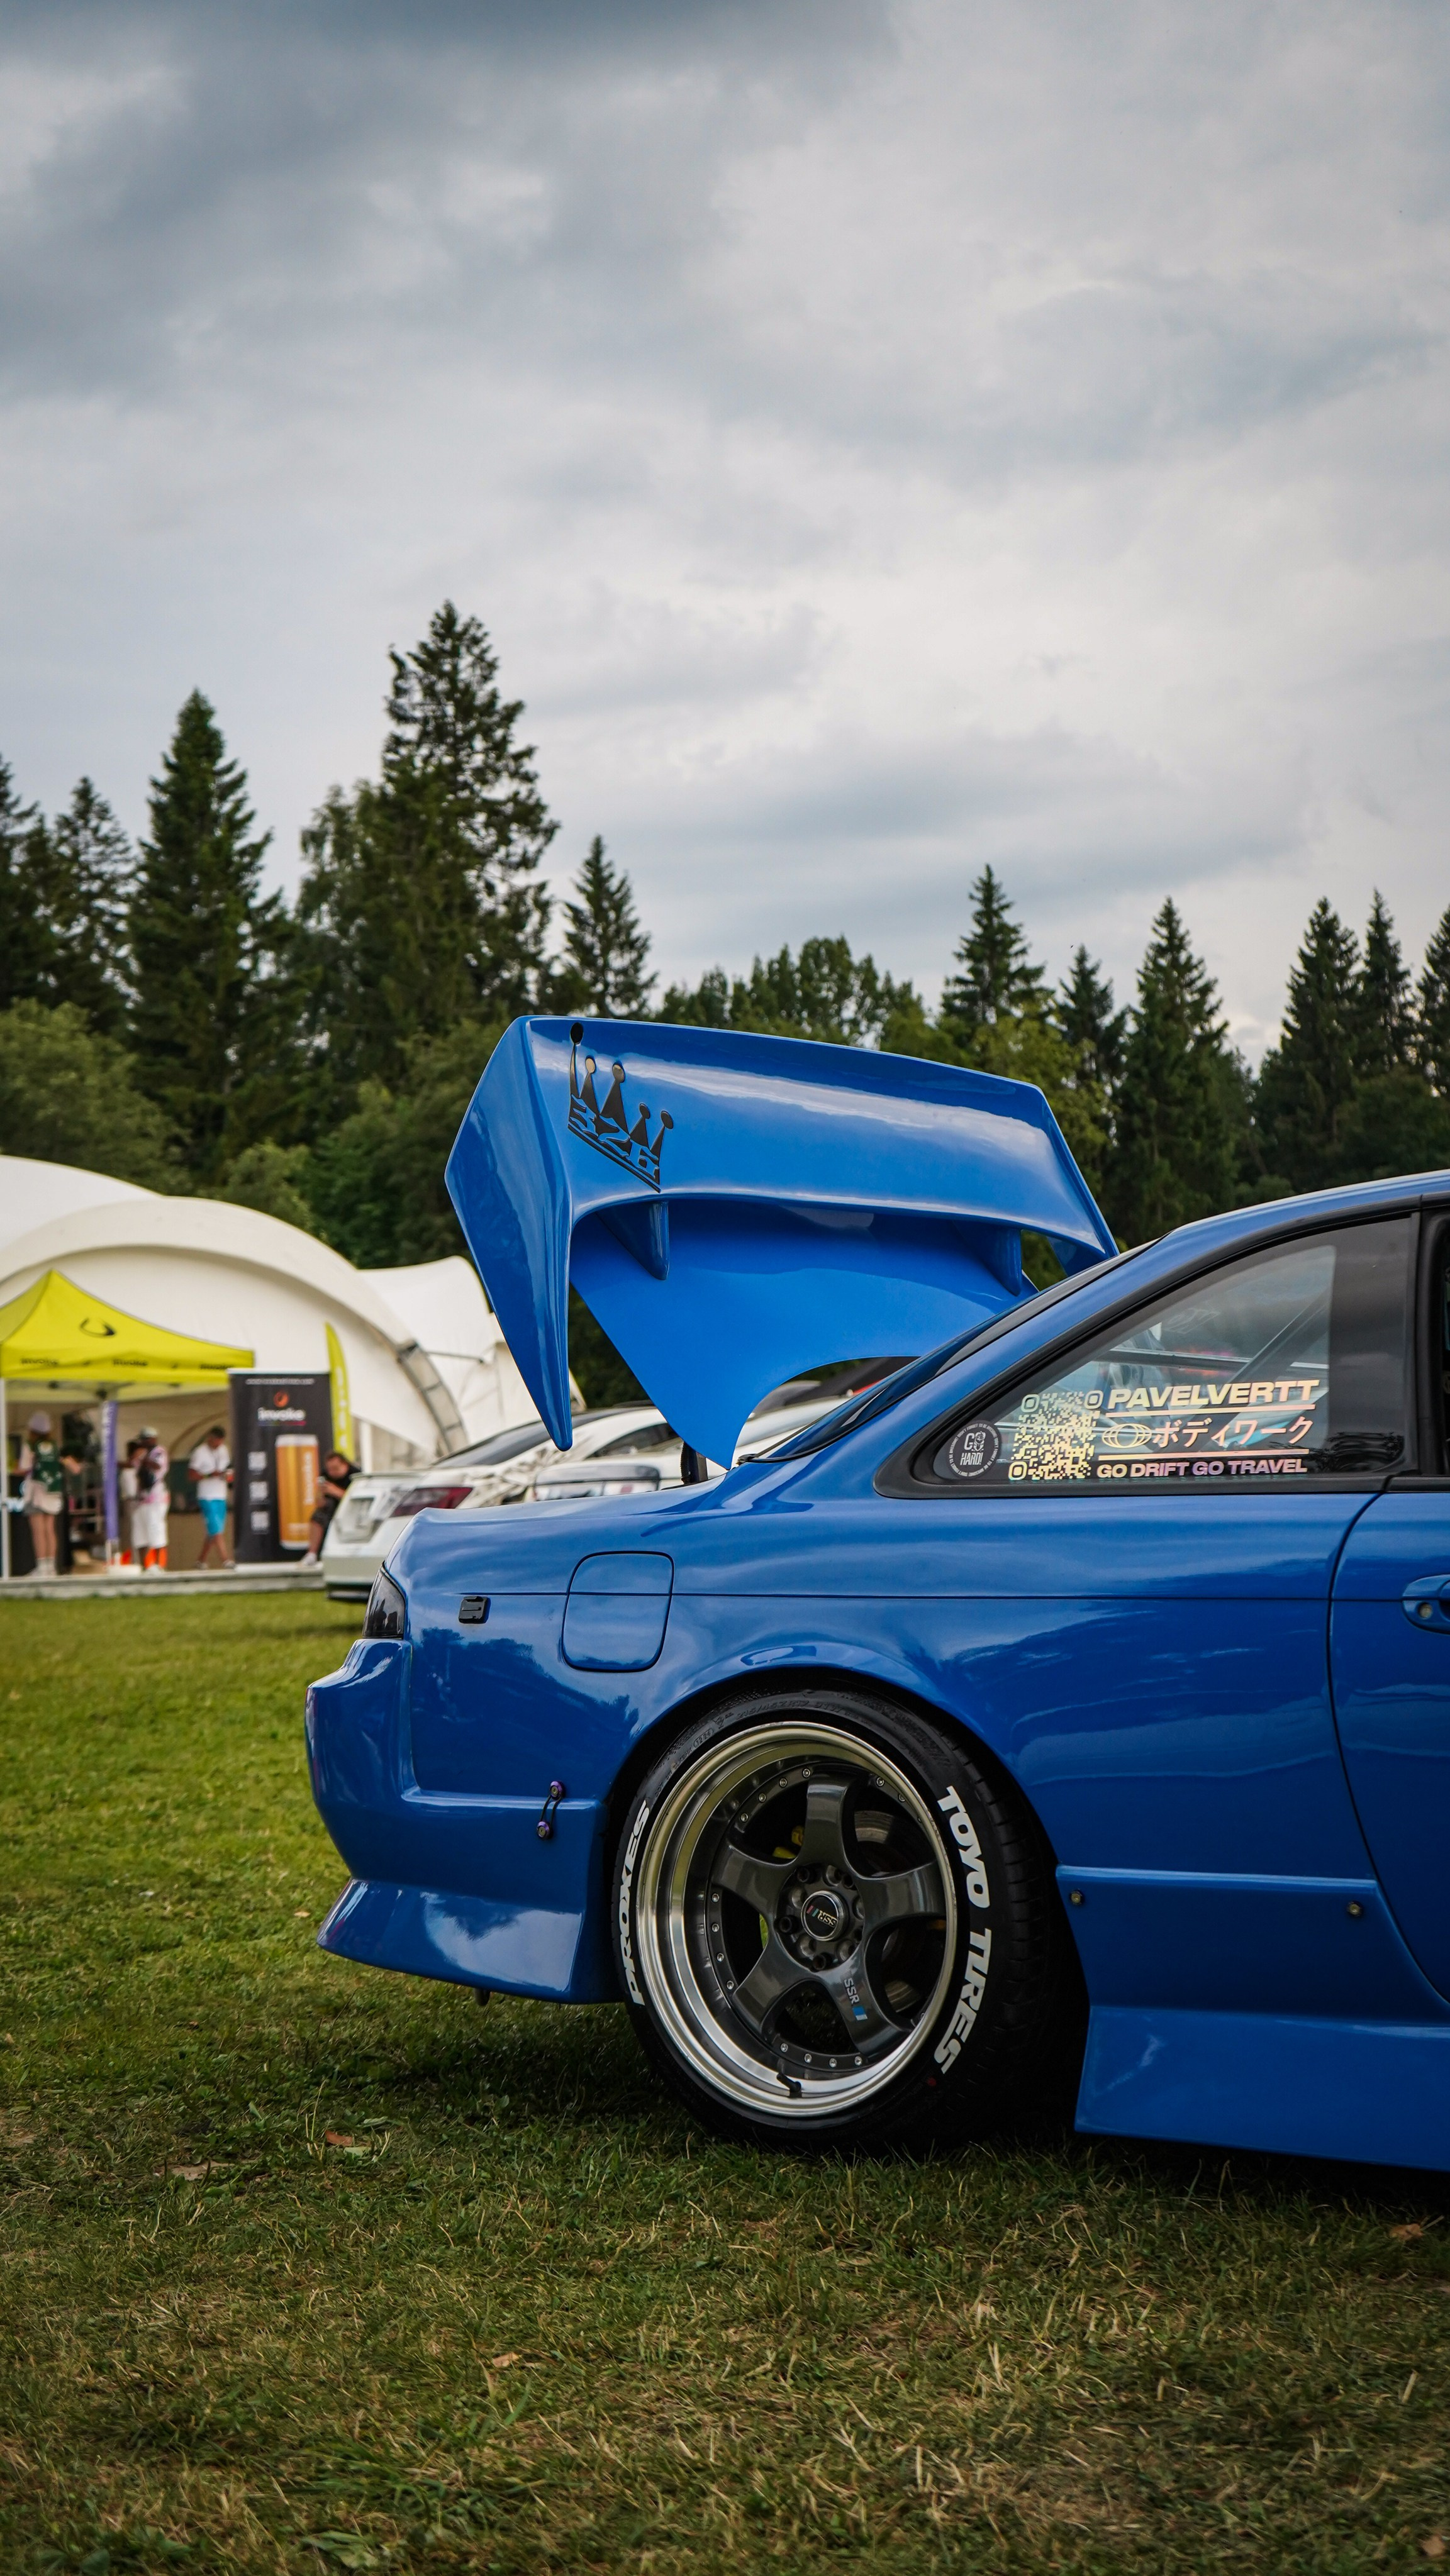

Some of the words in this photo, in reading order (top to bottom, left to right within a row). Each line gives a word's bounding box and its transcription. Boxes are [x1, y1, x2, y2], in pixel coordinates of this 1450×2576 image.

[1108, 1379, 1319, 1409] PAVELVERTT
[257, 1407, 306, 1421] invoke
[1152, 1416, 1313, 1448] ボディワーク
[960, 1452, 984, 1465] HARD!
[1096, 1464, 1127, 1478] GO
[1130, 1462, 1190, 1477] DRIFT
[1192, 1461, 1224, 1475] GO
[1226, 1459, 1308, 1474] TRAVEL
[937, 1785, 990, 1909] TOYO
[617, 1800, 652, 2006] PROXES
[818, 1910, 838, 1928] SSR
[844, 1977, 860, 2005] SSR
[934, 1928, 992, 2074] TIRES
